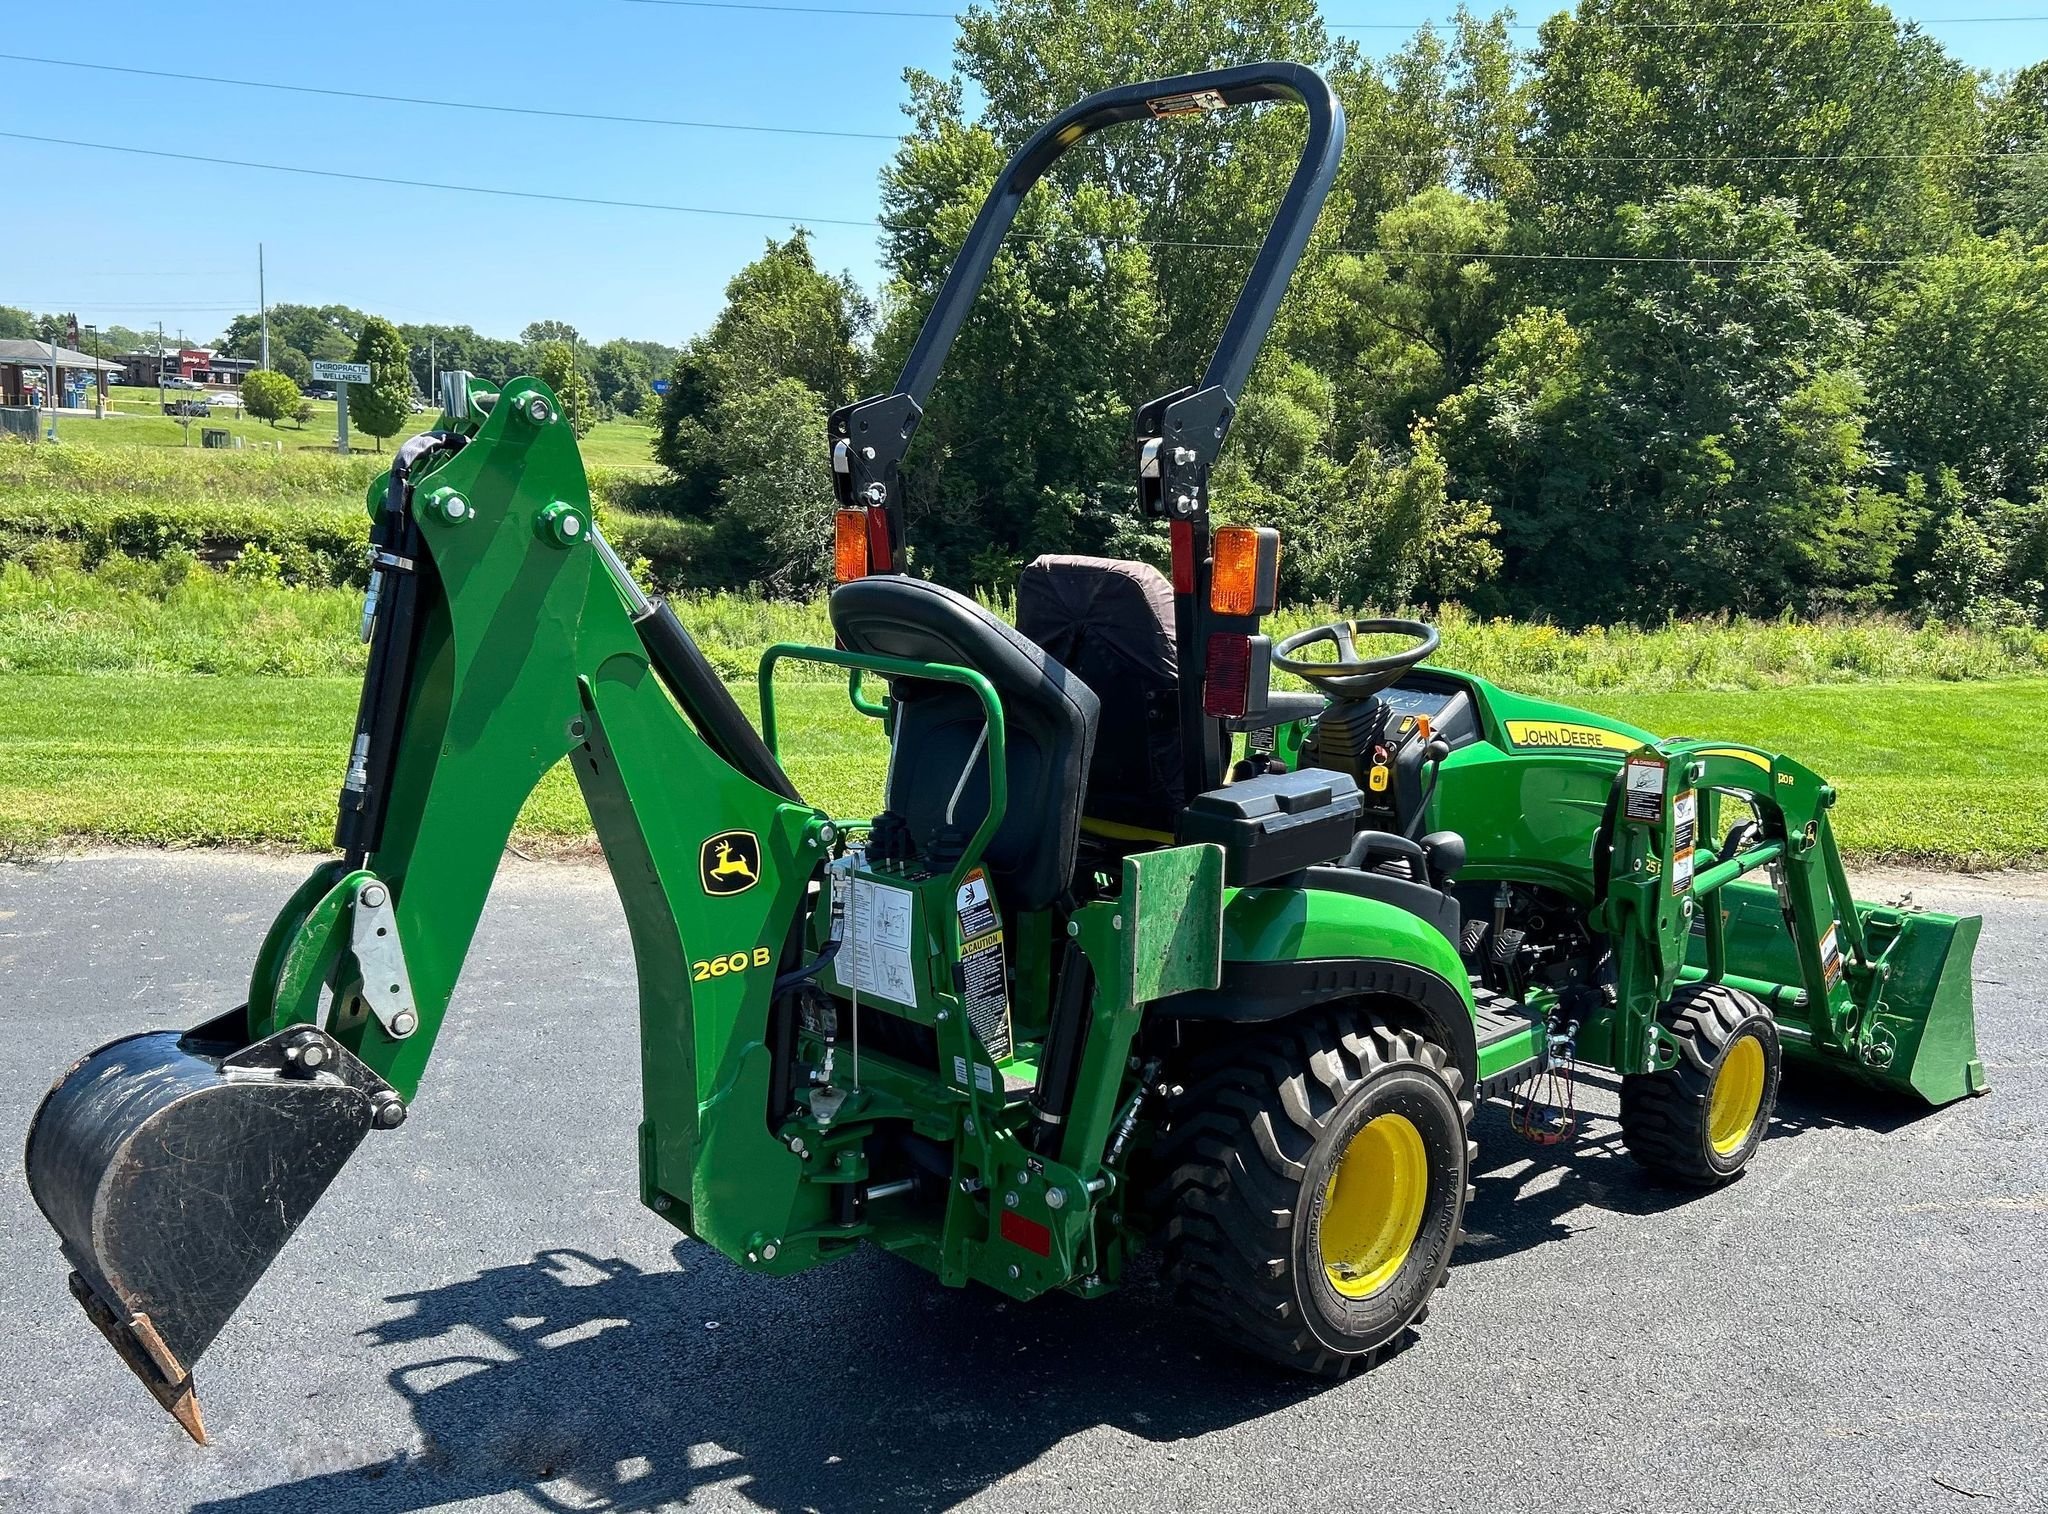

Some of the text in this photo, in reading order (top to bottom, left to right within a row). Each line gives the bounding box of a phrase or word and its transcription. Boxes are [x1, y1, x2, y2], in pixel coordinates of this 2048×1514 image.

[314, 362, 369, 373] CHIROPRACTIC
[322, 372, 362, 381] WELLNESS
[1521, 727, 1603, 746] JOHN DEERE
[1788, 775, 1794, 786] R
[968, 933, 998, 952] CAUTION
[692, 946, 771, 983] 260 B
